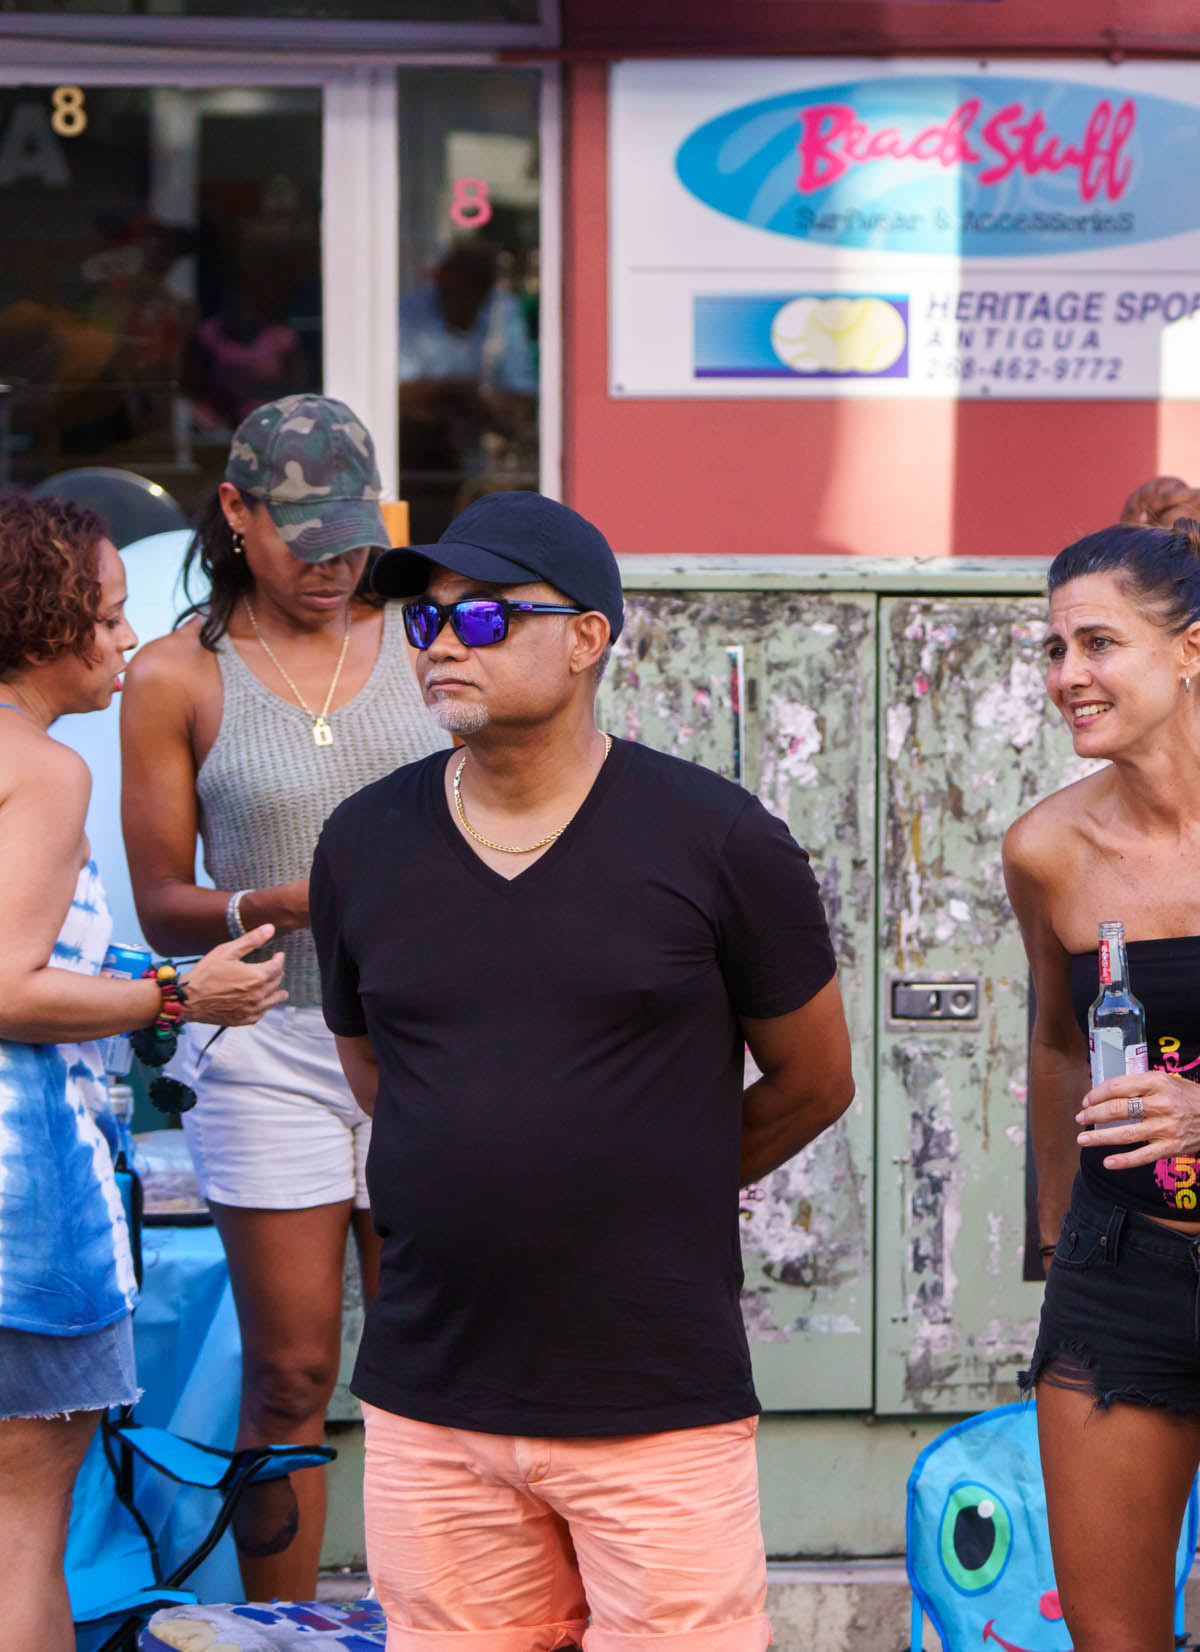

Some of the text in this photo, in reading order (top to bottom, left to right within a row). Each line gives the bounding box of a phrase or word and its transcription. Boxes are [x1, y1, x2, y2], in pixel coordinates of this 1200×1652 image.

[51, 84, 88, 138] 8
[977, 97, 1136, 204] Stuff
[450, 178, 493, 229] 8
[927, 290, 1106, 323] HERITAGE
[924, 328, 1102, 351] ANTIGUA
